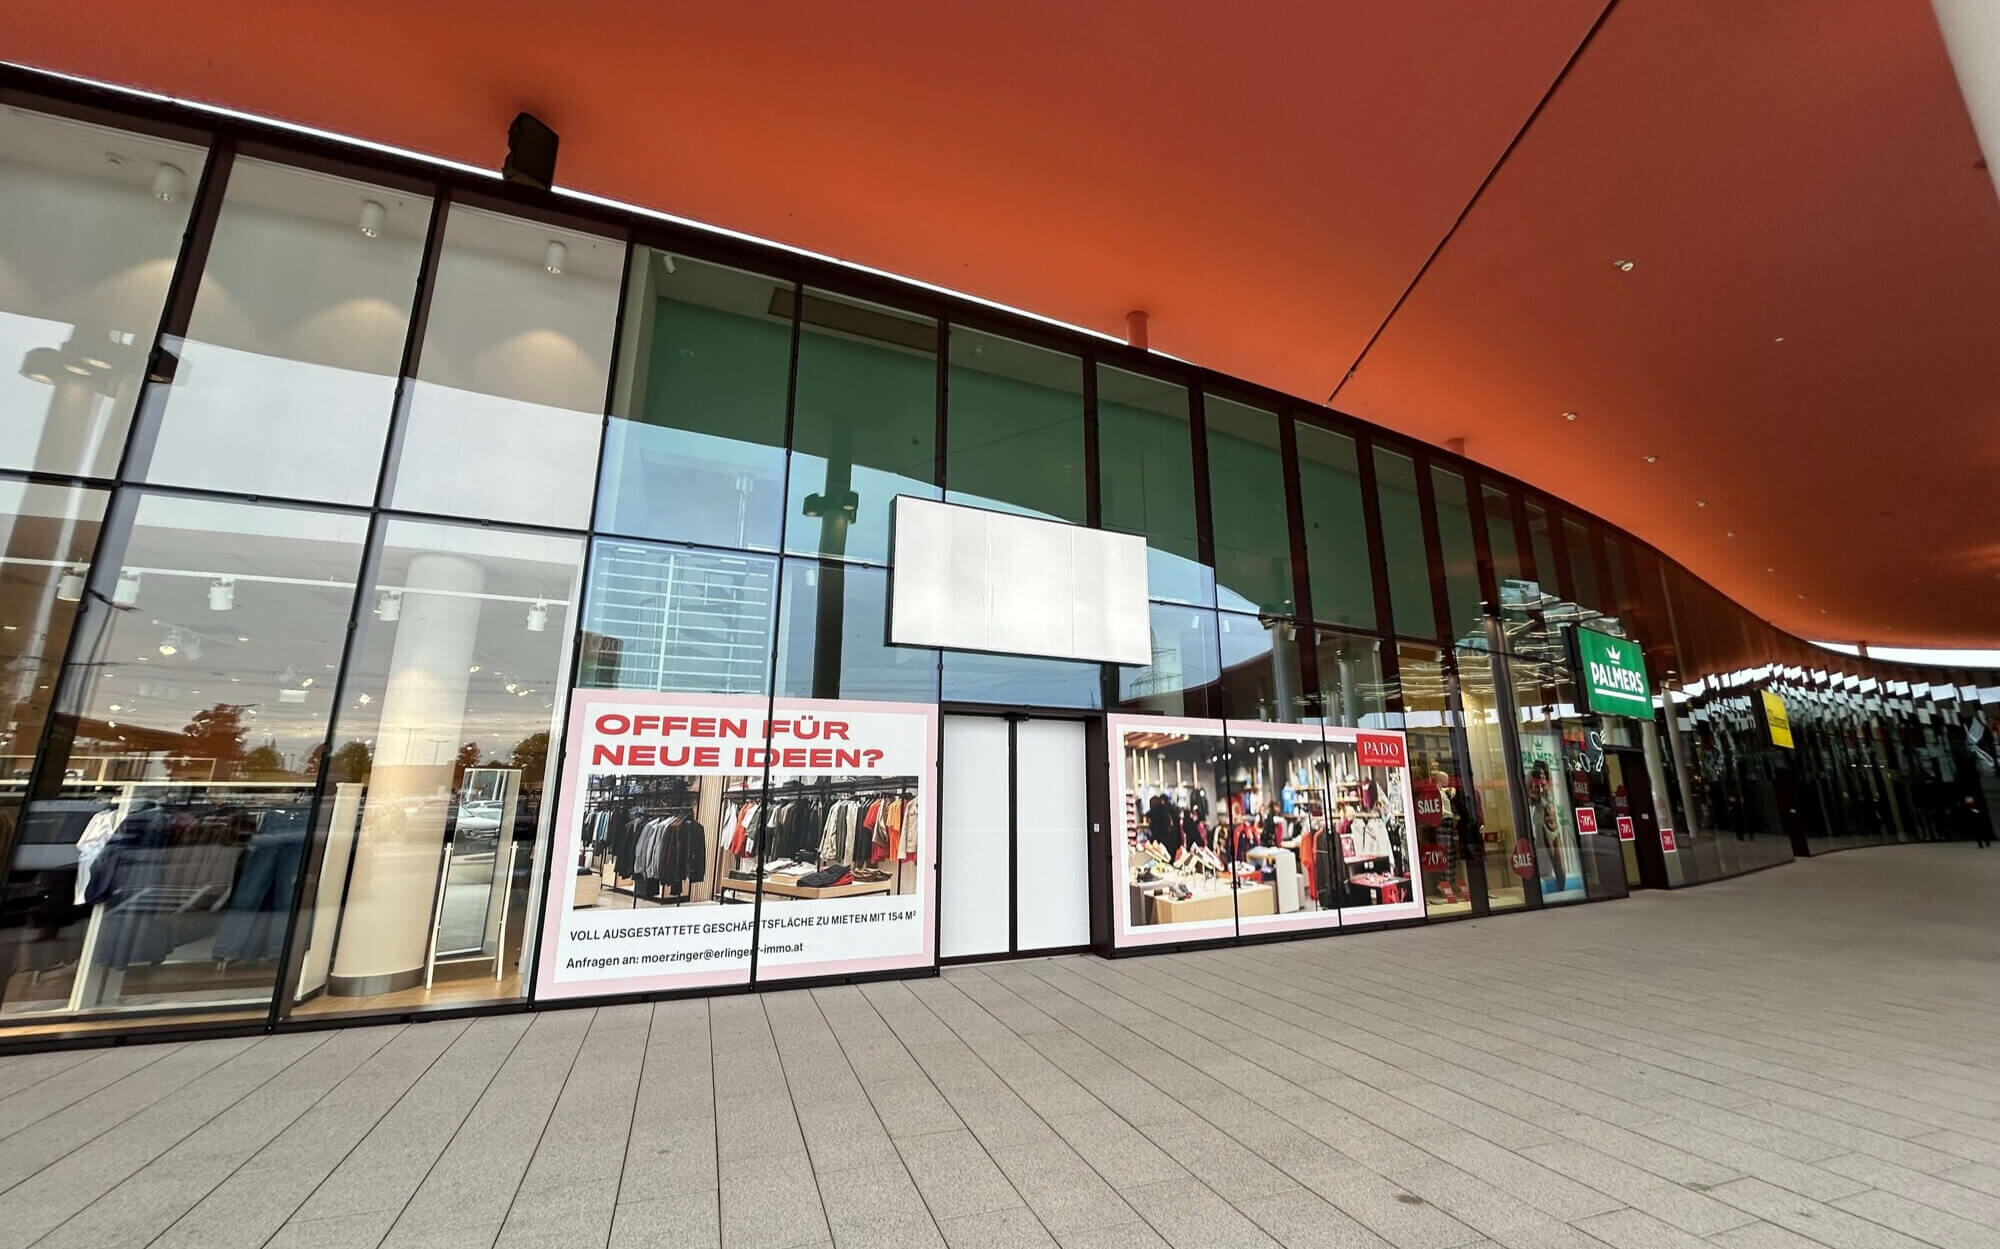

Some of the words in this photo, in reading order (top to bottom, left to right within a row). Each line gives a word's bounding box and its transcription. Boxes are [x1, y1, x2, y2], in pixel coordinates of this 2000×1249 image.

[1590, 661, 1645, 694] PALMERS
[595, 714, 747, 738] OFFEN
[762, 716, 850, 740] FÜR
[592, 745, 720, 767] NEUE
[734, 748, 884, 768] IDEEN?
[1363, 741, 1399, 757] PADO
[1573, 781, 1589, 794] SALE
[1418, 799, 1441, 815] SALE
[1422, 850, 1447, 866] -70%
[1513, 853, 1532, 869] SALE
[570, 929, 600, 941] VOLL
[603, 924, 700, 940] AUSGESTATTETE
[702, 916, 814, 934] GESCHÄFTSFLÄCHE
[816, 916, 829, 926] ZU
[831, 914, 867, 925] MIETEN
[869, 912, 886, 922] MIT
[888, 911, 903, 921] 154
[905, 910, 917, 921] M²
[566, 957, 620, 969] Anfragen
[622, 956, 639, 965] an:
